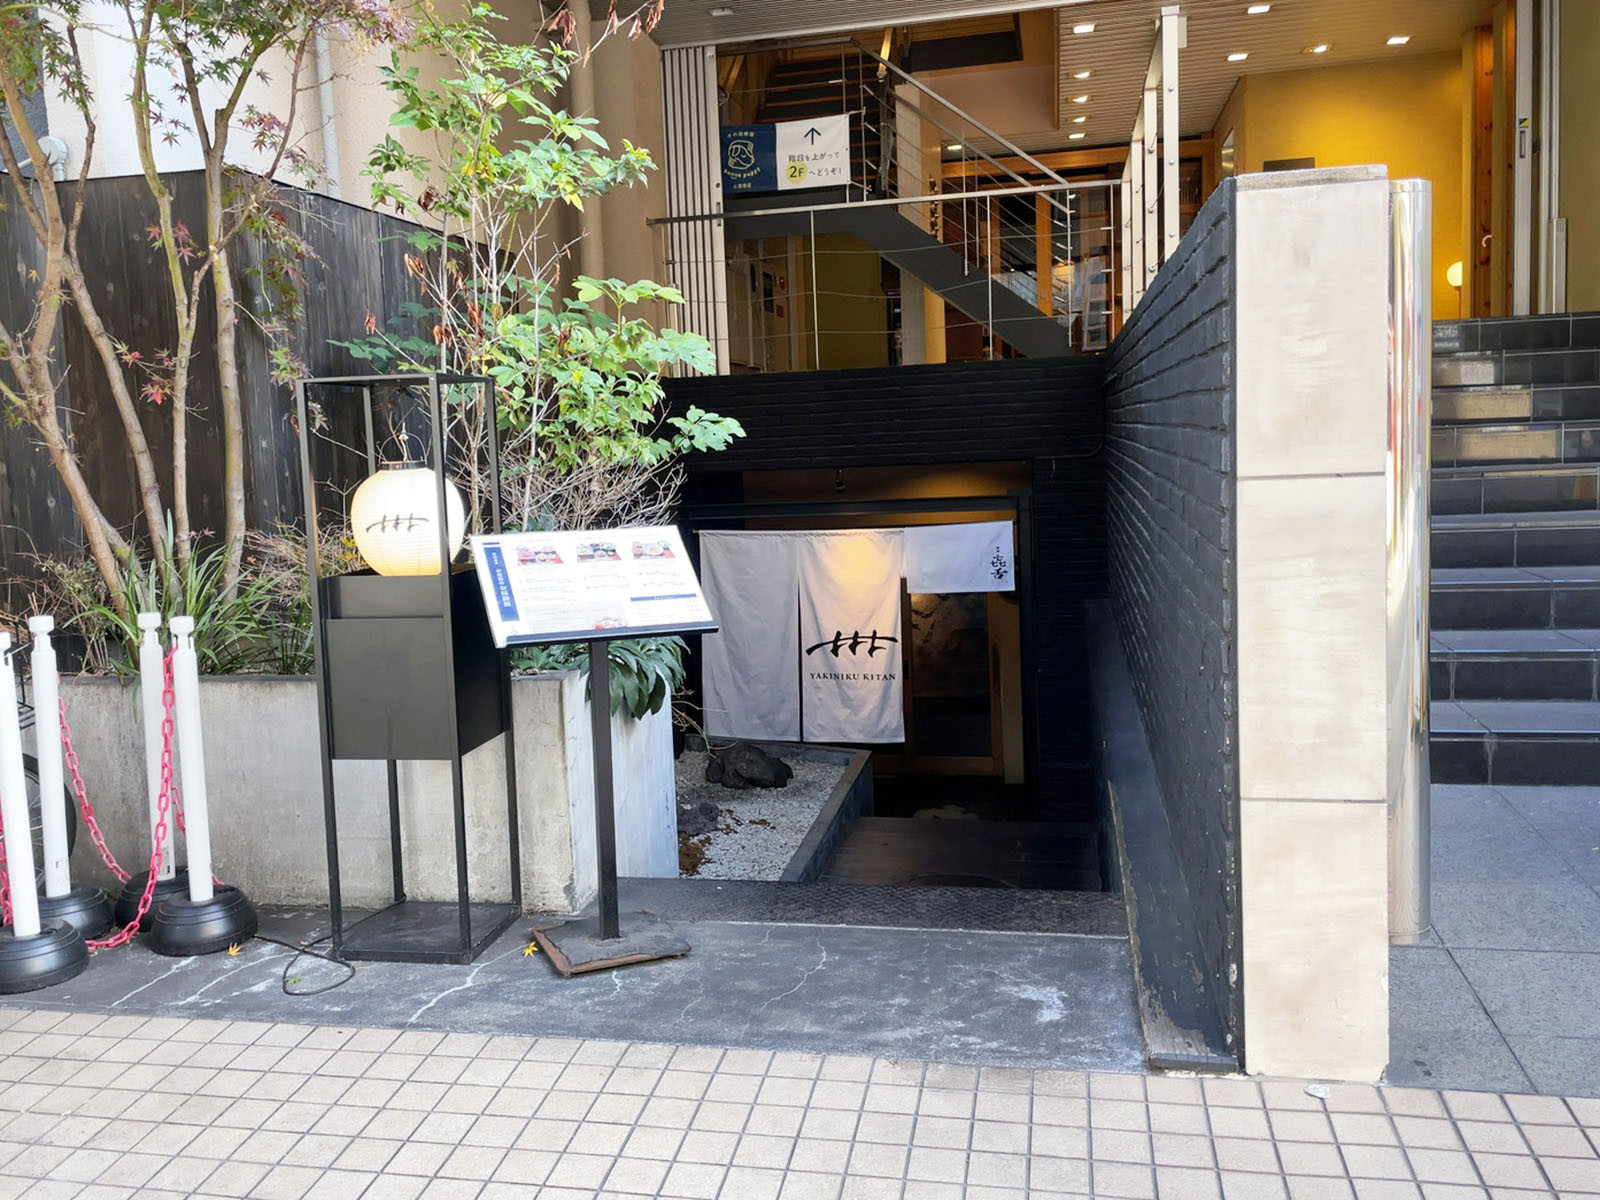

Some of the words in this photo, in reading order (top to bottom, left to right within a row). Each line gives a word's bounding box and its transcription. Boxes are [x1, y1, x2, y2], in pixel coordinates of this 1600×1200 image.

[788, 151, 840, 162] 階段を上がって
[809, 672, 860, 681] YAKINIKU
[863, 672, 897, 681] KITAN
